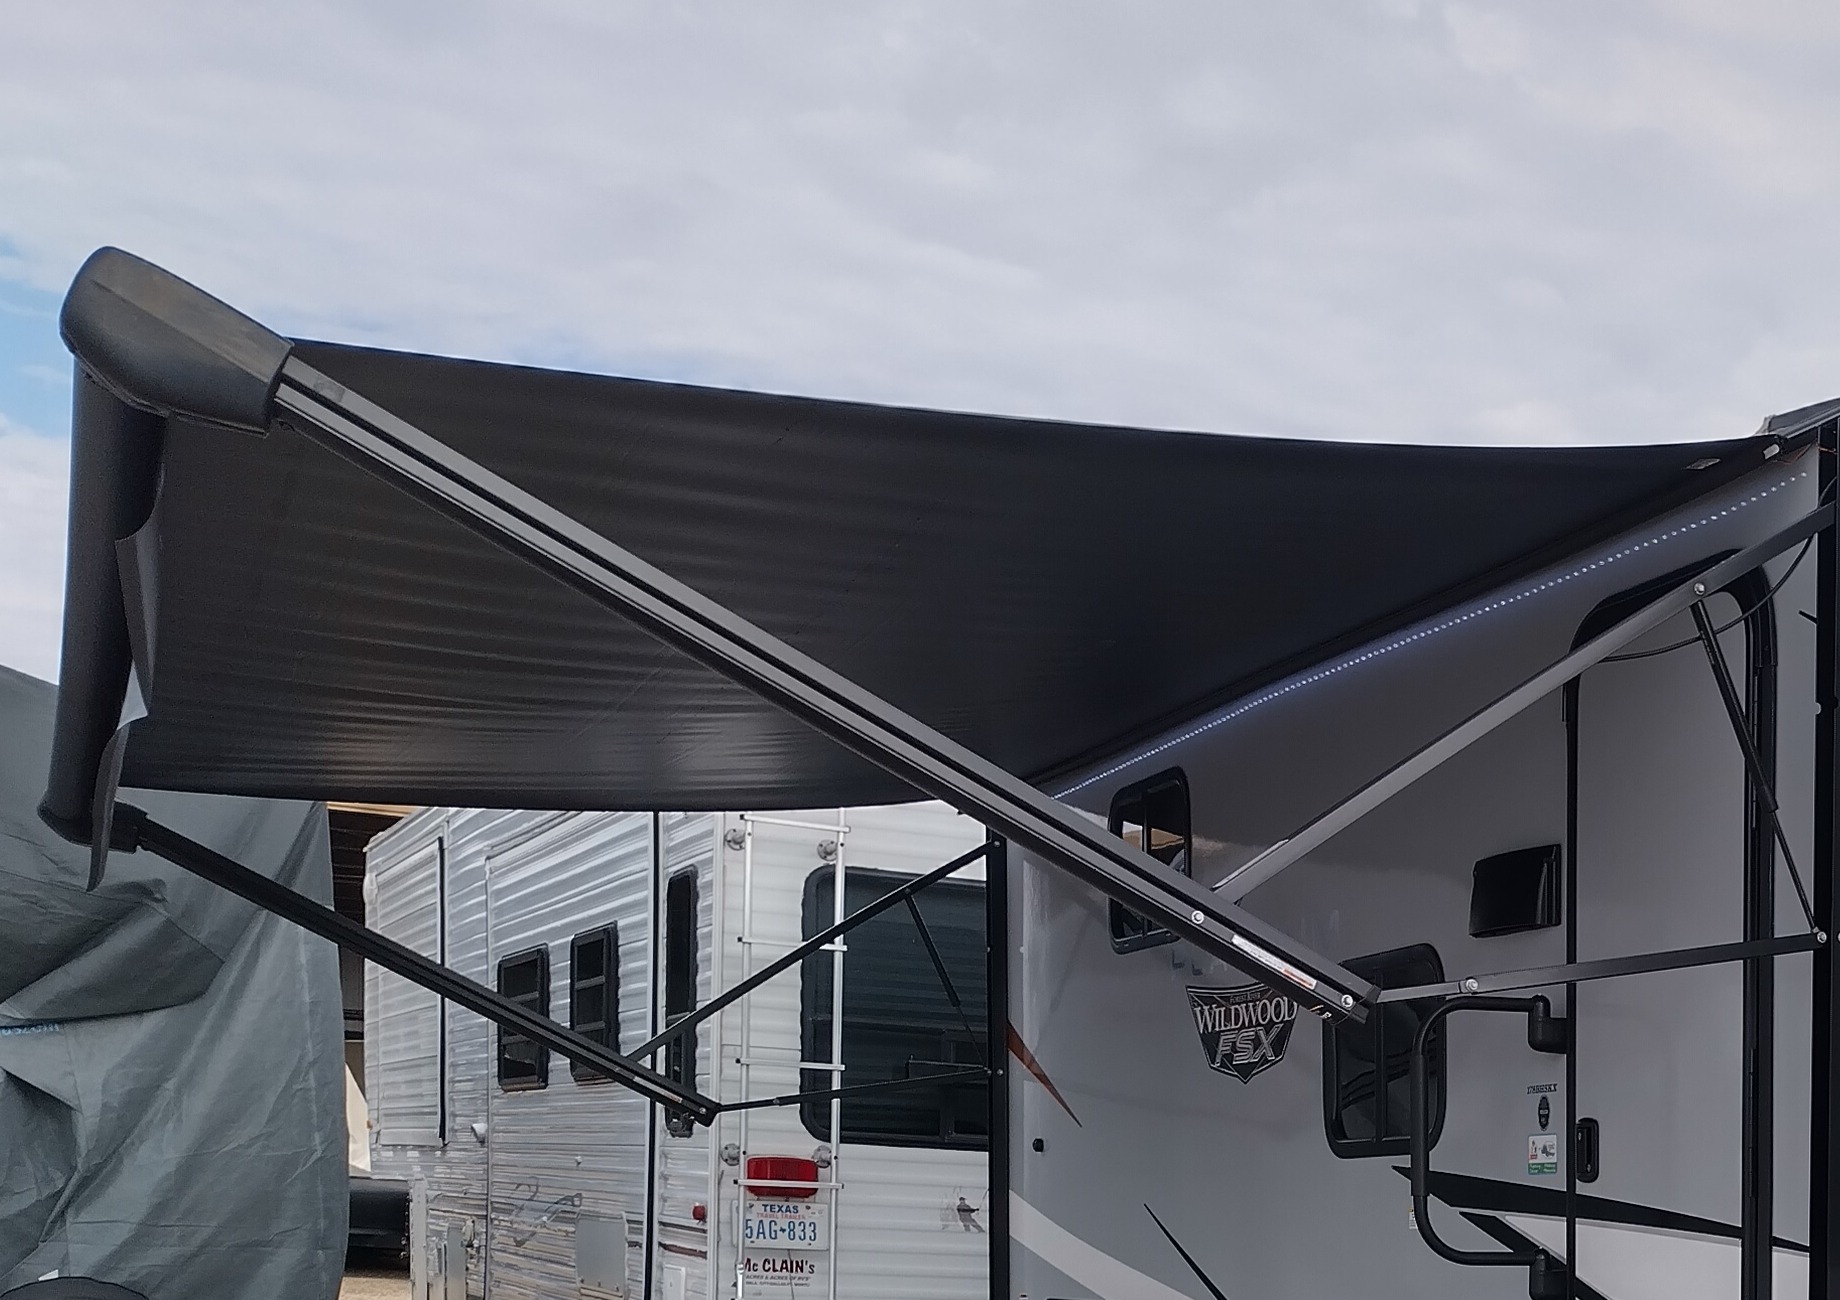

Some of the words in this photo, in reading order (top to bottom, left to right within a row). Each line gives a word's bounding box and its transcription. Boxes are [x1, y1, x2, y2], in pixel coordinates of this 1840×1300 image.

[1194, 996, 1298, 1034] WILDWOOD
[1215, 1023, 1284, 1067] FSX
[761, 1203, 799, 1214] TEXAS
